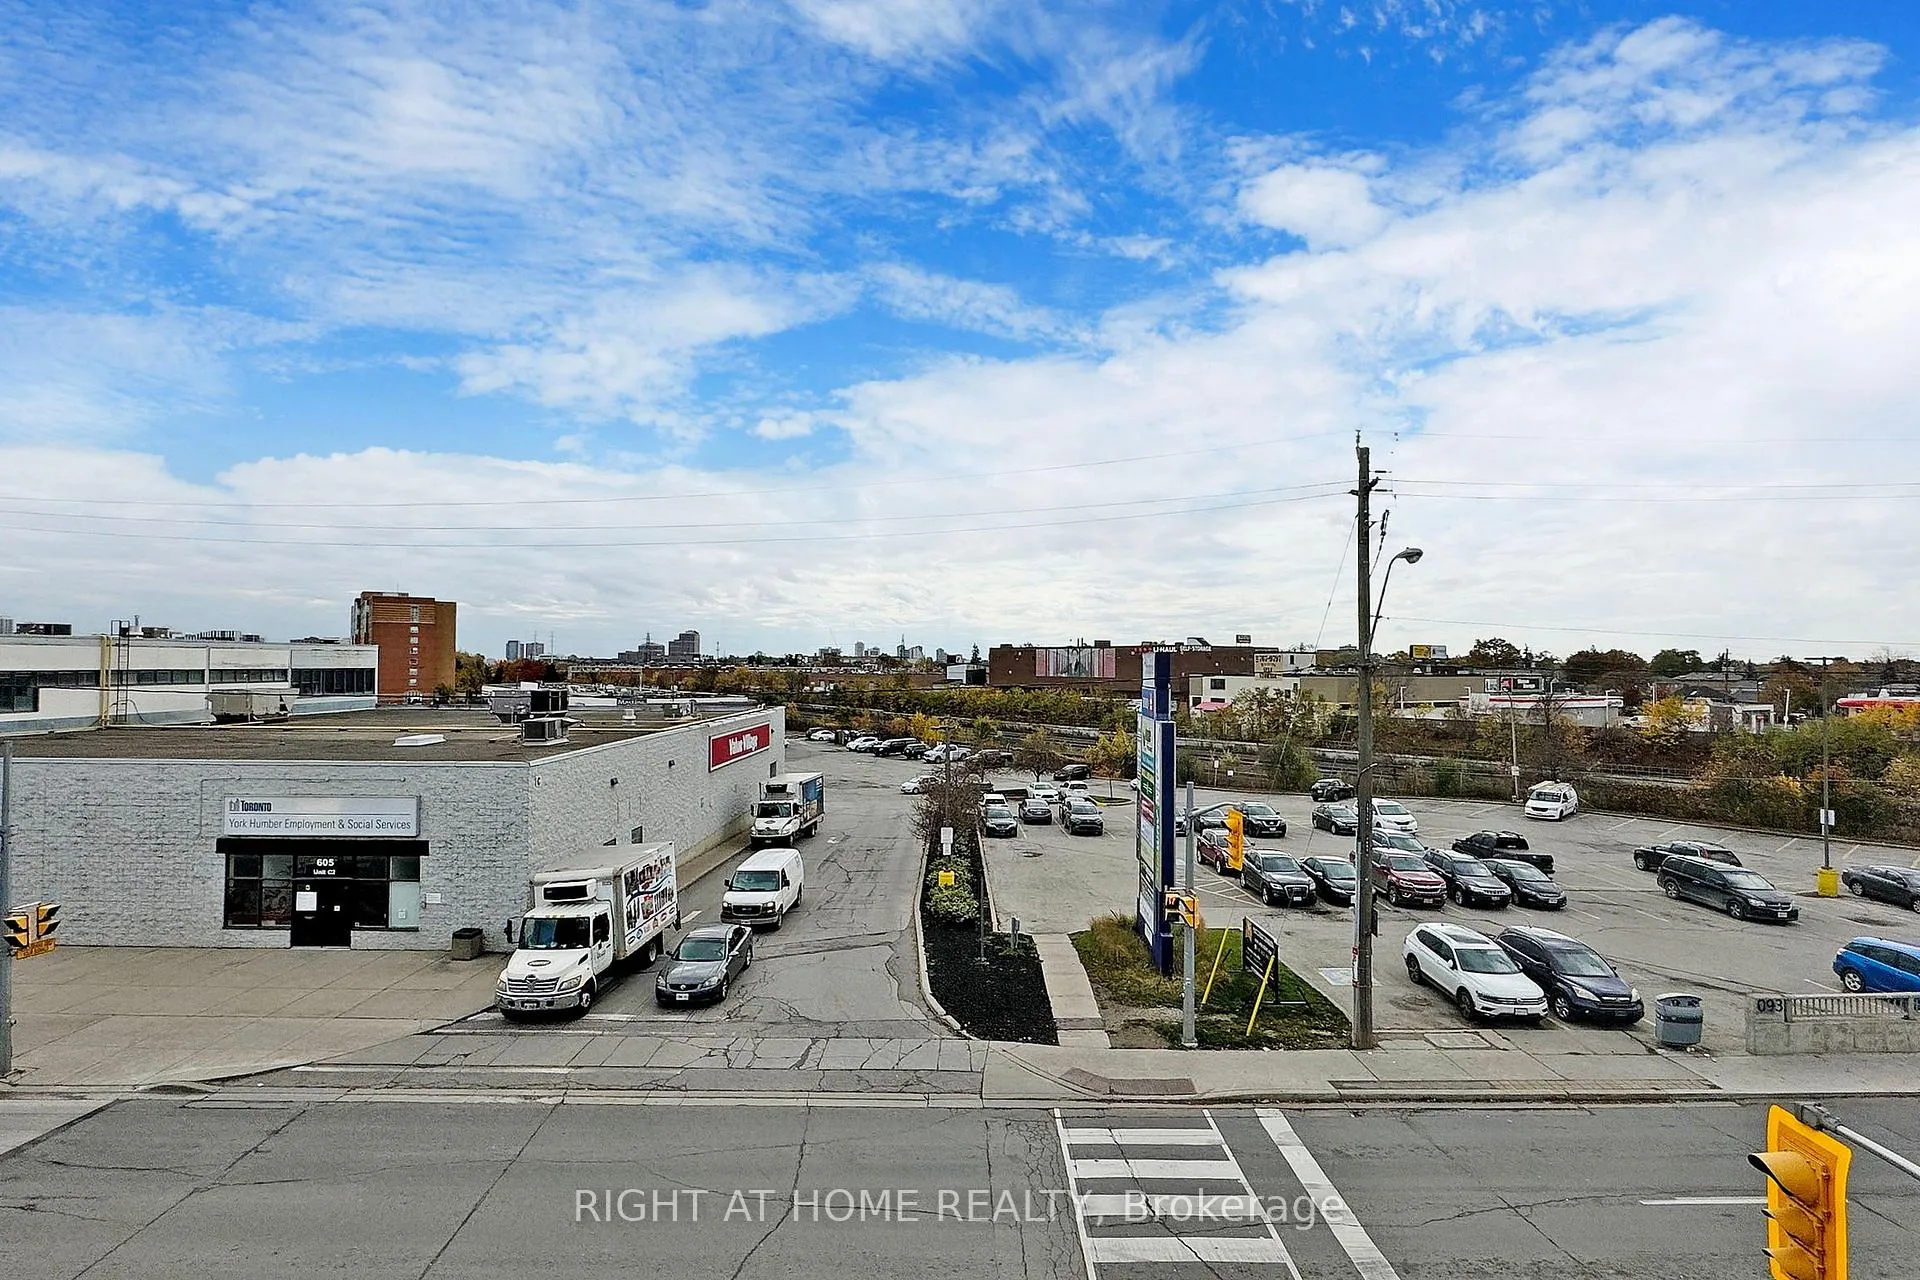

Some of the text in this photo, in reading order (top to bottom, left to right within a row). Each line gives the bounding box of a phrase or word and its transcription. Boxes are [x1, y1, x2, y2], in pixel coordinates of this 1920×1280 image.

[241, 800, 272, 812] TORONTO
[229, 818, 411, 831] York Humber Employment & Social Services
[316, 858, 335, 867] 605
[1757, 998, 1783, 1013] 093
